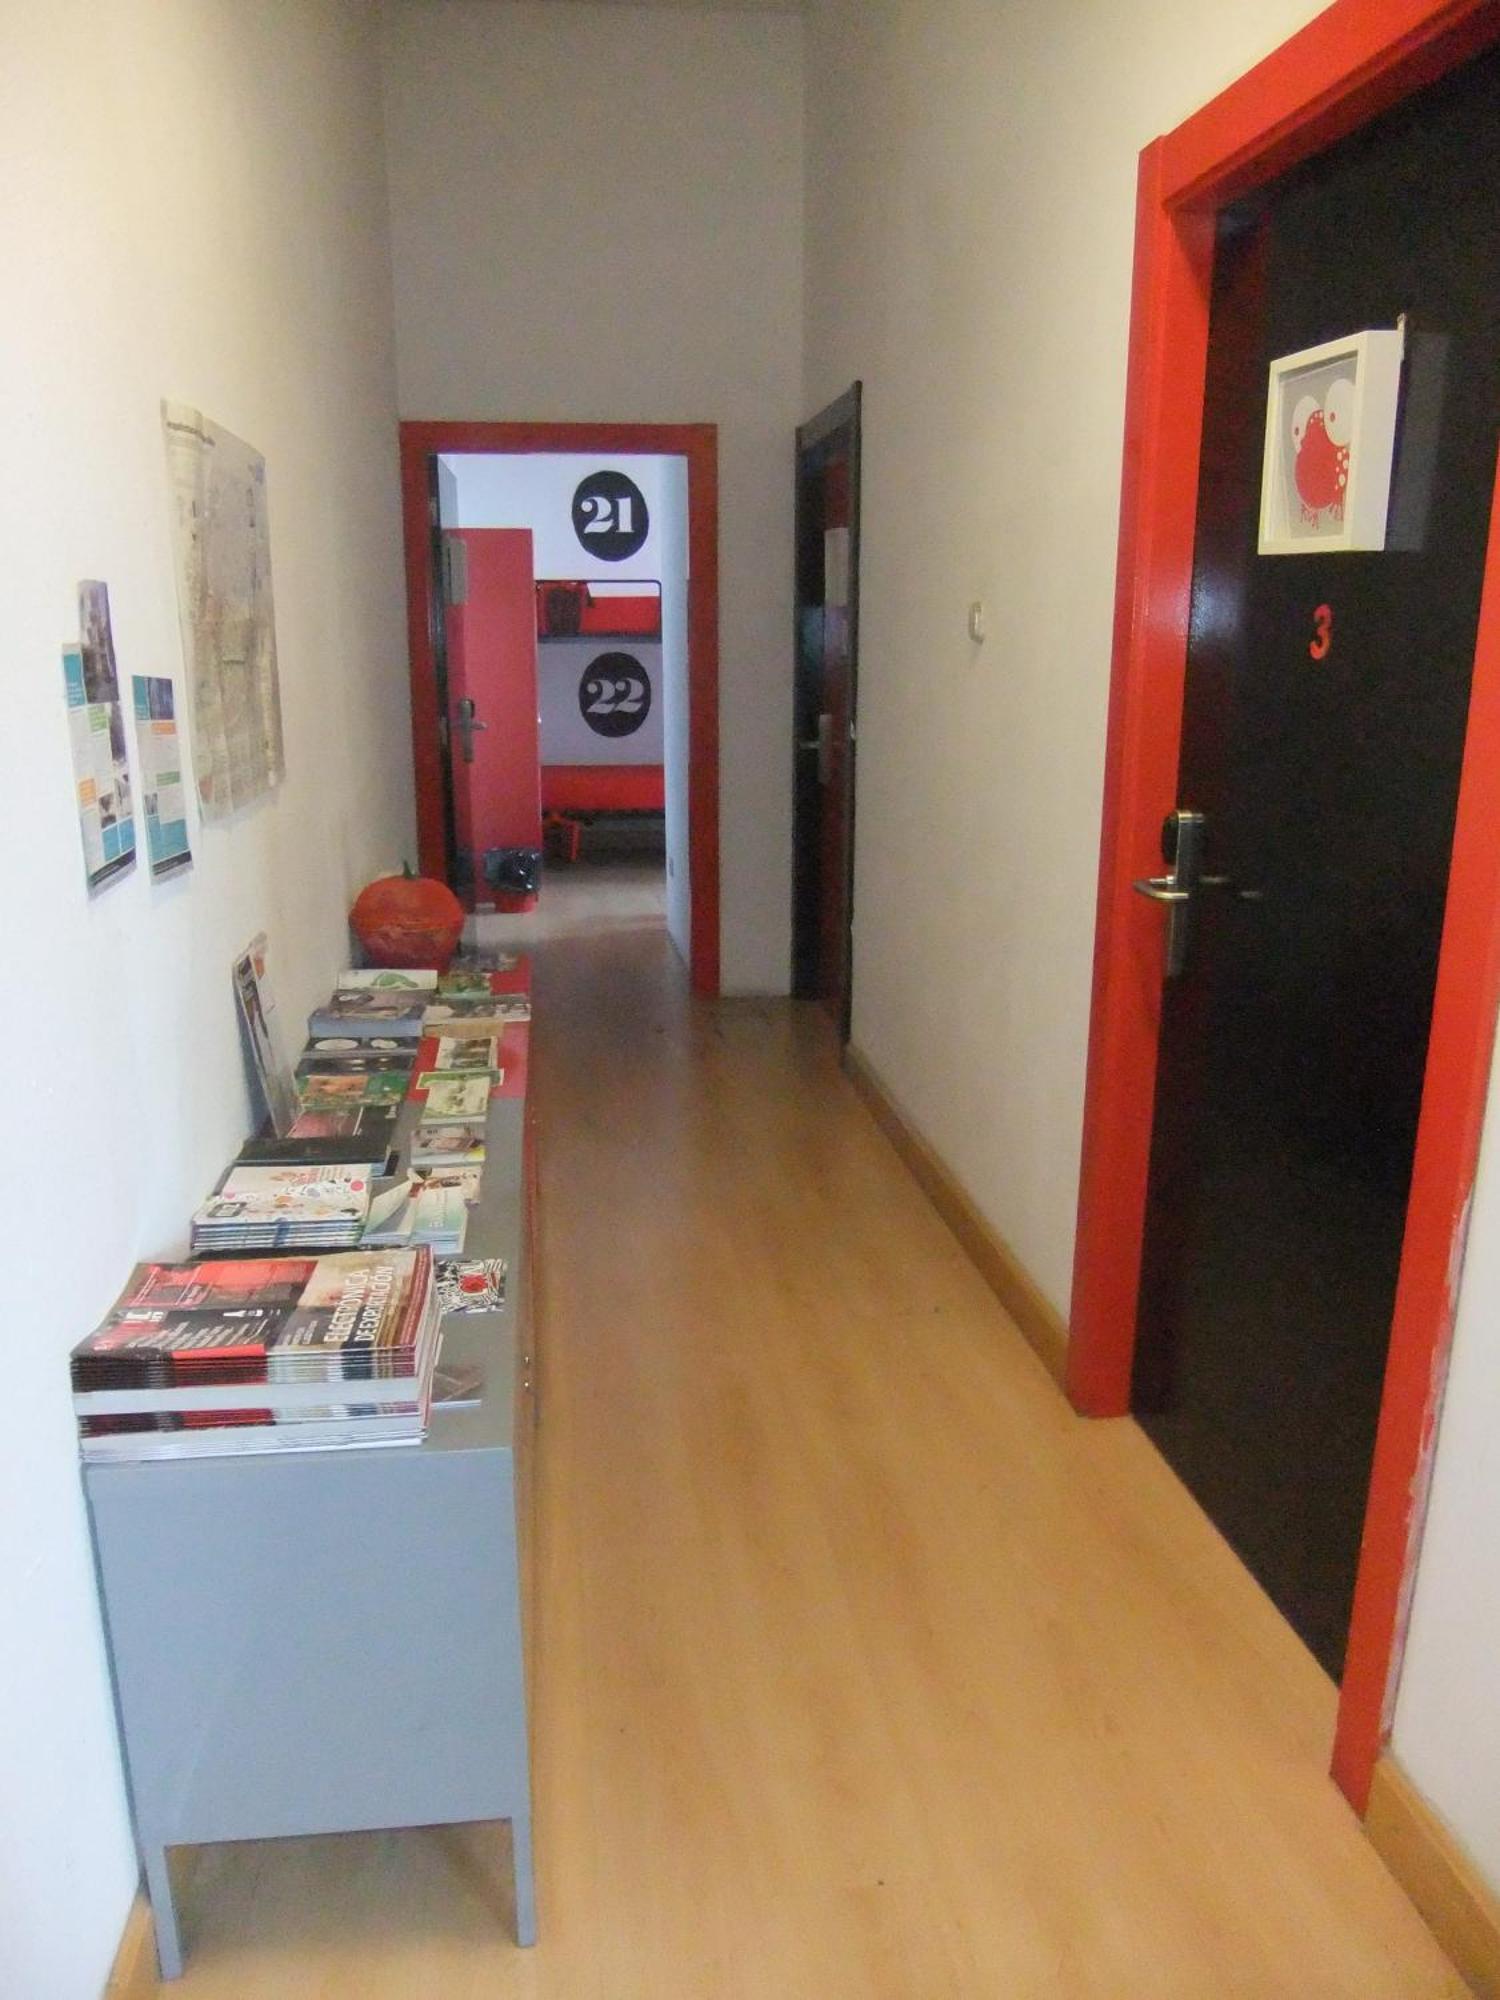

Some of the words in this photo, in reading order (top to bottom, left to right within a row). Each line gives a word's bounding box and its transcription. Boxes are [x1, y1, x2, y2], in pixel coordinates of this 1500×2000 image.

[581, 497, 635, 534] 21
[1310, 604, 1332, 660] 3
[586, 678, 644, 714] 22
